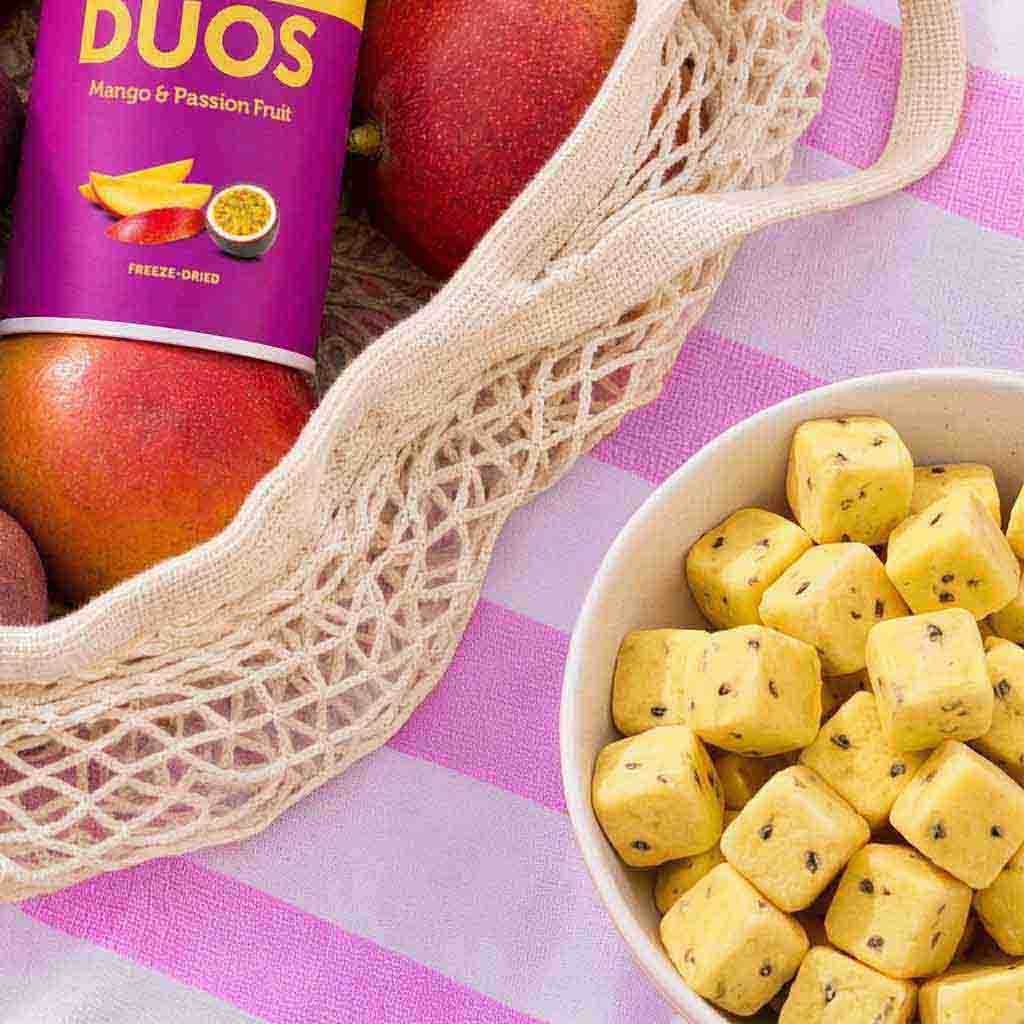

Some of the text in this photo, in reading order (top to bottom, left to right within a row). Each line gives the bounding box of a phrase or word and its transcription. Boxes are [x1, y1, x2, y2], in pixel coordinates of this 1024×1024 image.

[88, 79, 294, 123] Mango & Passion Fruit
[127, 261, 220, 285] FREEZE-DRIED
